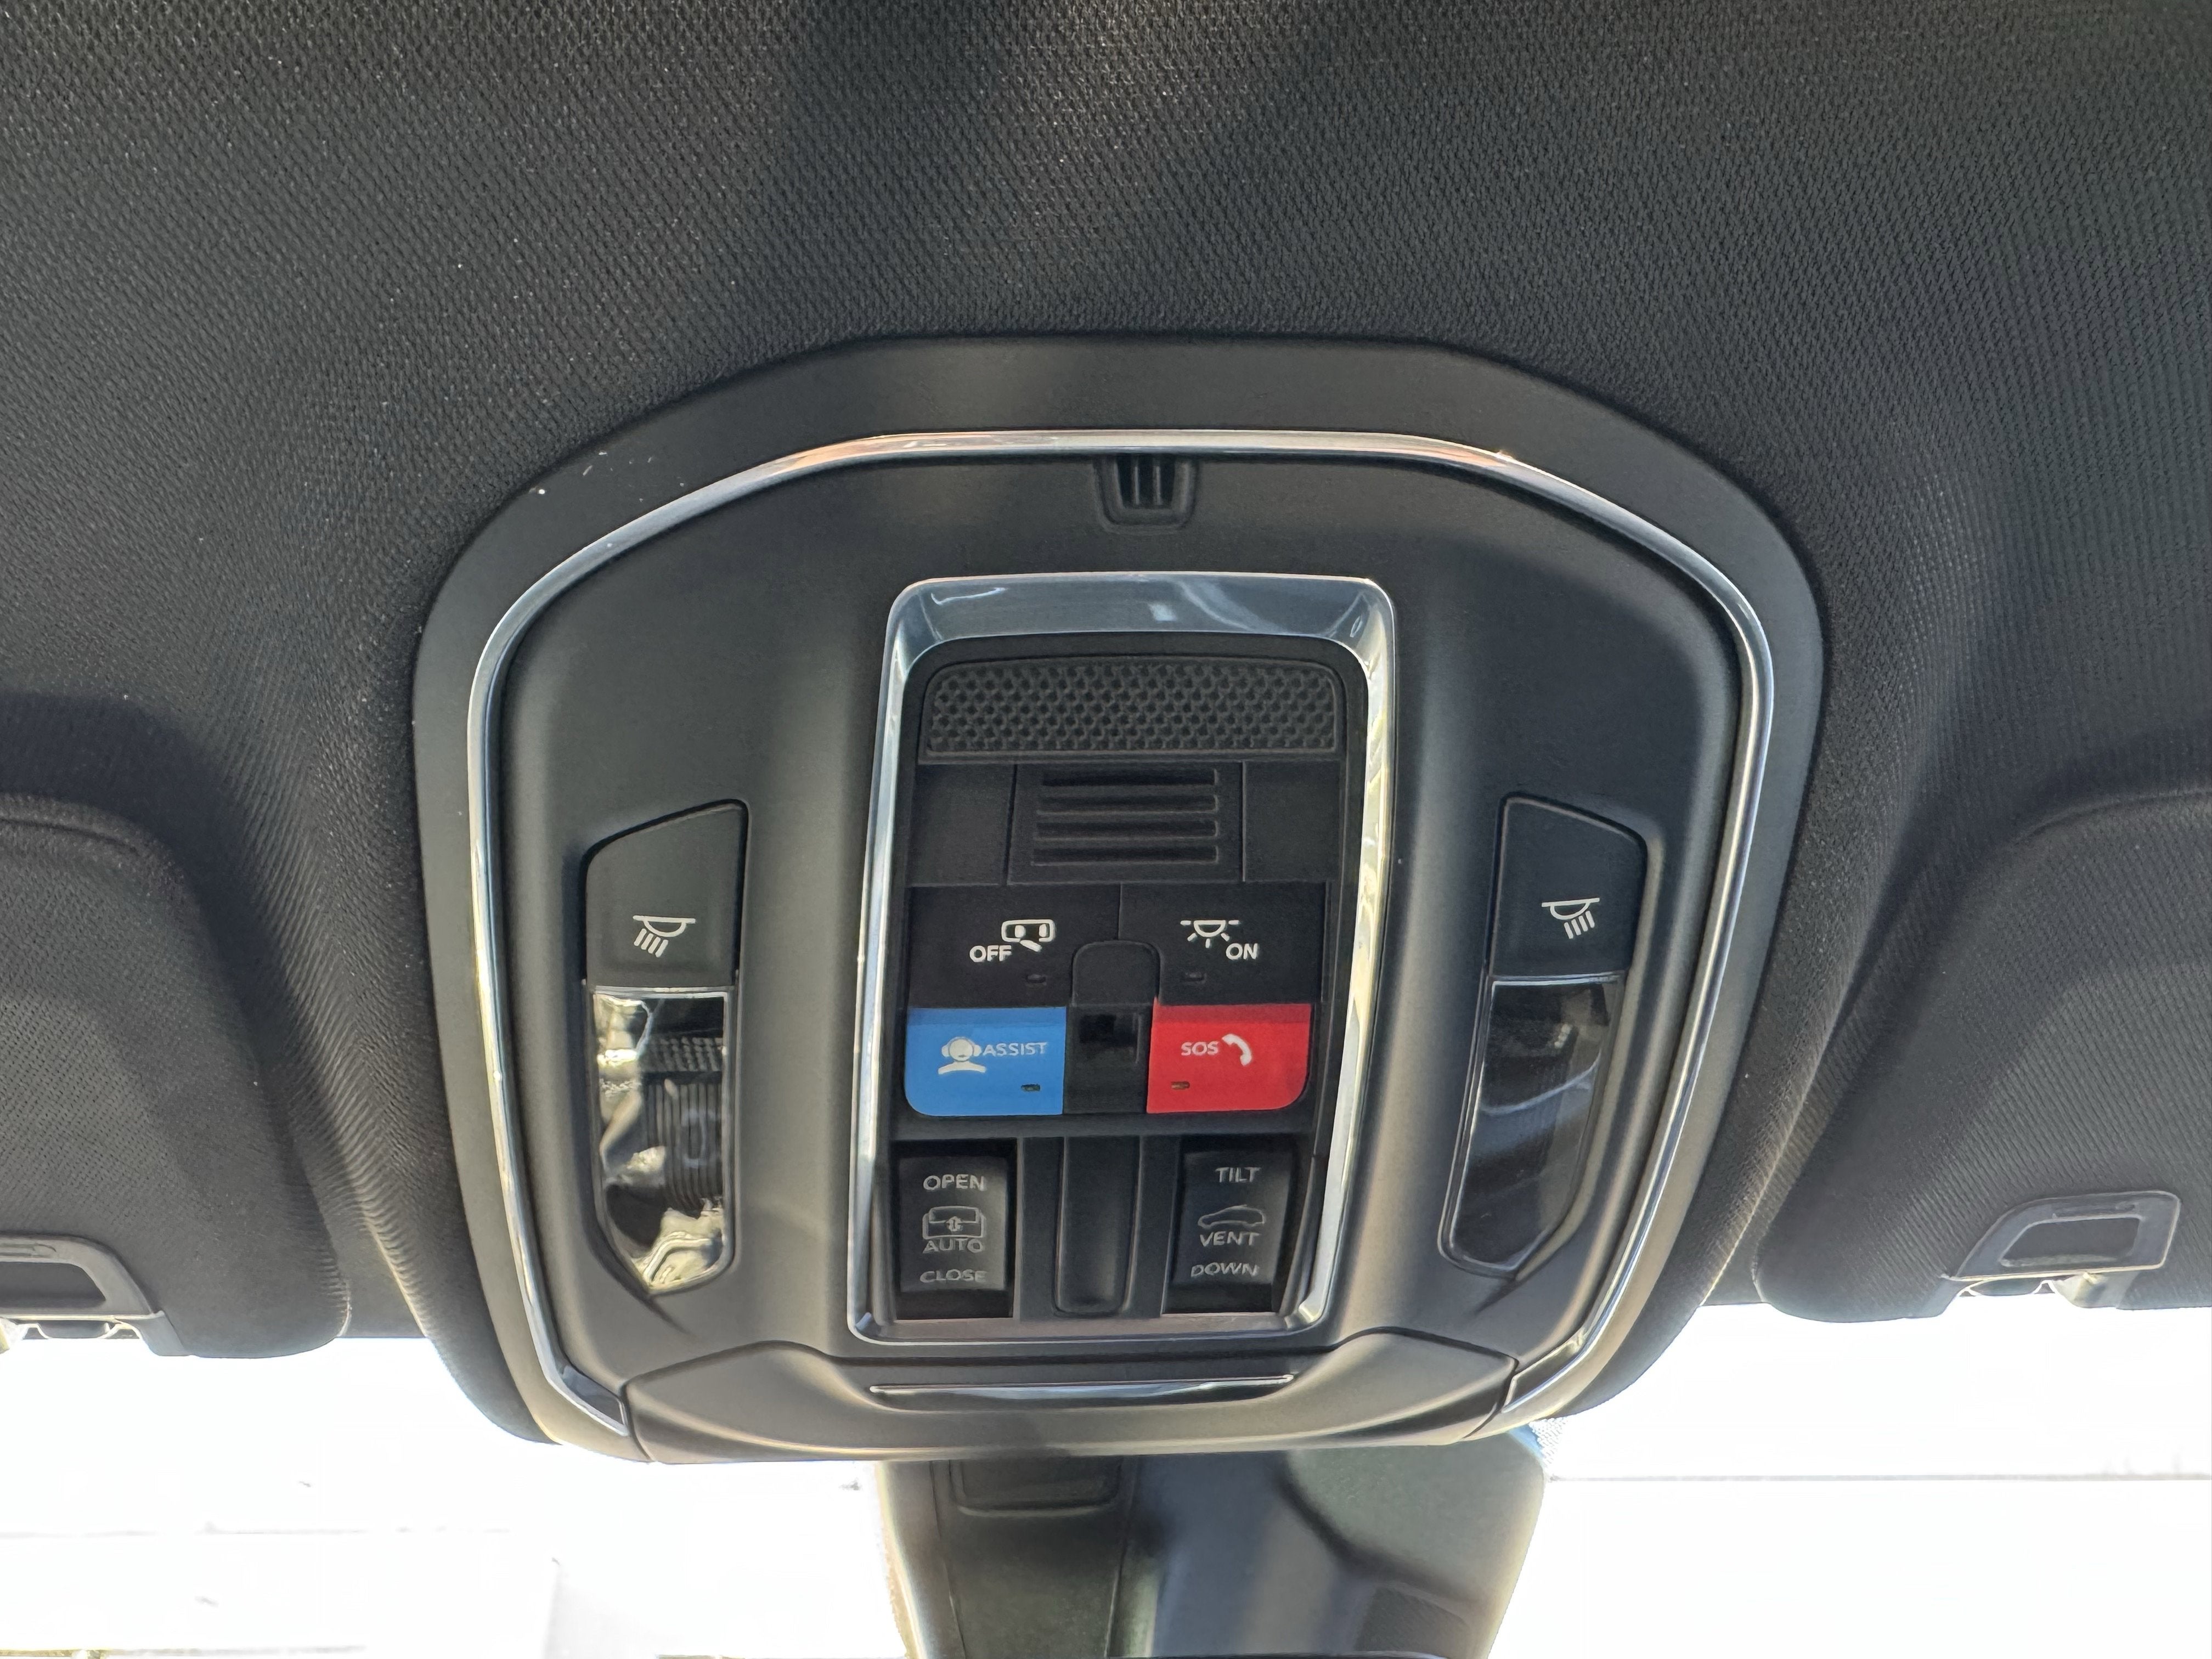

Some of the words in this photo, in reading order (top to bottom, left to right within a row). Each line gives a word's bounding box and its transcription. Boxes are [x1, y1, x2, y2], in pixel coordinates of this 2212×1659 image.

[969, 945, 1012, 962] OFF
[1226, 943, 1259, 960] ON
[982, 1042, 1047, 1057] ASSIST
[1181, 1041, 1218, 1056] SOS
[1215, 1166, 1260, 1183] TILT
[923, 1174, 986, 1192] OPEN
[922, 1238, 986, 1254] AUTO
[1199, 1231, 1260, 1247] VENT
[919, 1268, 987, 1284] CLOSE
[1190, 1262, 1259, 1278] DOWN
